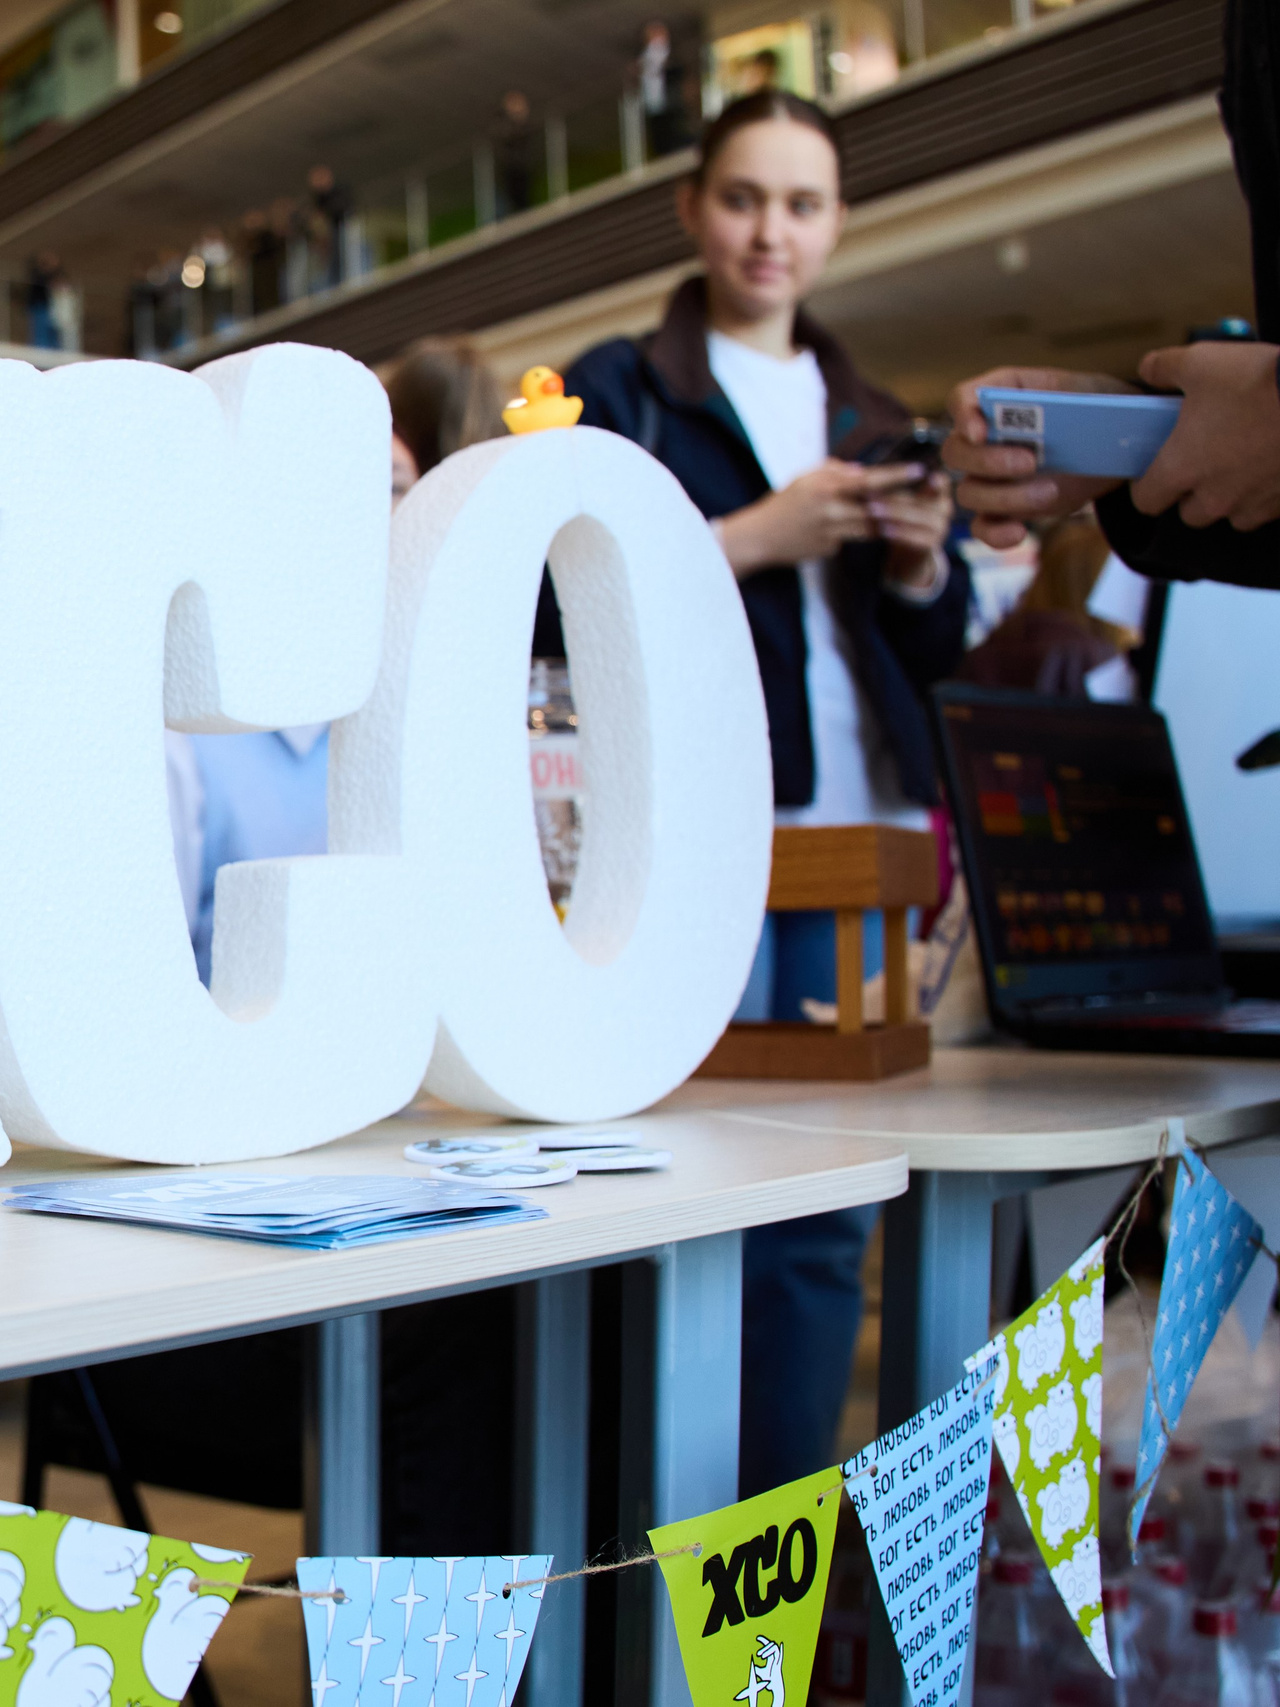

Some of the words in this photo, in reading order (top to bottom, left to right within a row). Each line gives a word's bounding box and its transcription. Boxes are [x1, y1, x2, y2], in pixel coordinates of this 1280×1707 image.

[873, 1467, 896, 1501] БОГ
[901, 1442, 934, 1480] ЕСТЬ
[937, 1405, 981, 1454] ЛЮБОВЬ
[882, 1482, 931, 1534] ЛЮБОВЬ
[935, 1461, 955, 1493] БОГ
[960, 1436, 988, 1473] ЕСТЬ
[879, 1539, 900, 1573] БОГ
[905, 1513, 937, 1551] ЕСТЬ
[941, 1475, 986, 1524] ЛЮБОВЬ
[702, 1518, 818, 1638] ХСО
[886, 1552, 934, 1605] ЛЮБОВЬ
[938, 1529, 958, 1561] БОГ
[910, 1582, 940, 1621] ЕСТЬ
[941, 1597, 961, 1630] БОГ
[913, 1650, 943, 1690] ЕСТЬ
[943, 1664, 961, 1695] БОГ
